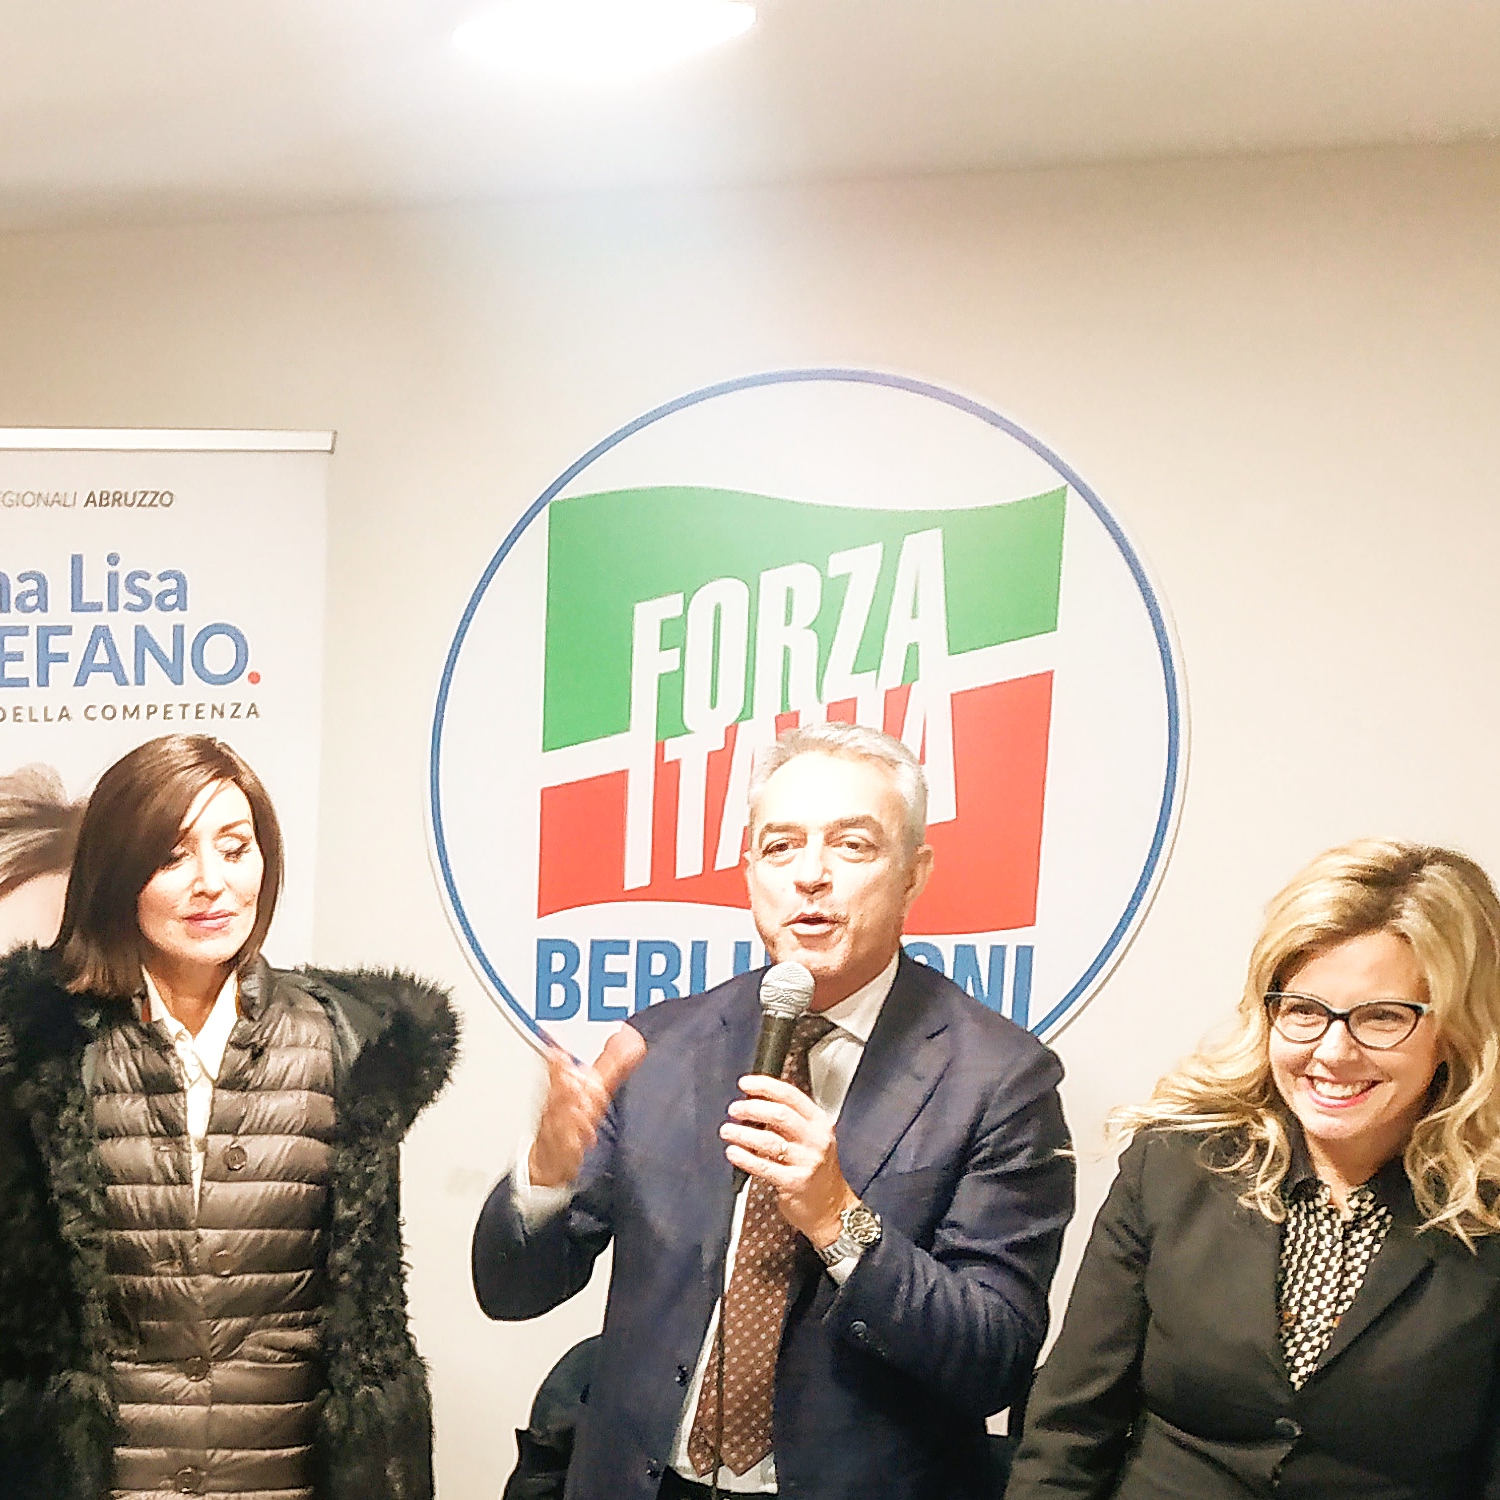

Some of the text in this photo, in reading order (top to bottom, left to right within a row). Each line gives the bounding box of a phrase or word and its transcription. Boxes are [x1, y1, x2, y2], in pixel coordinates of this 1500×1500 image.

[83, 490, 175, 508] ABRUZZO
[70, 551, 189, 614] Lisa
[629, 527, 950, 735] FORZA
[83, 702, 261, 722] COMPETENZA
